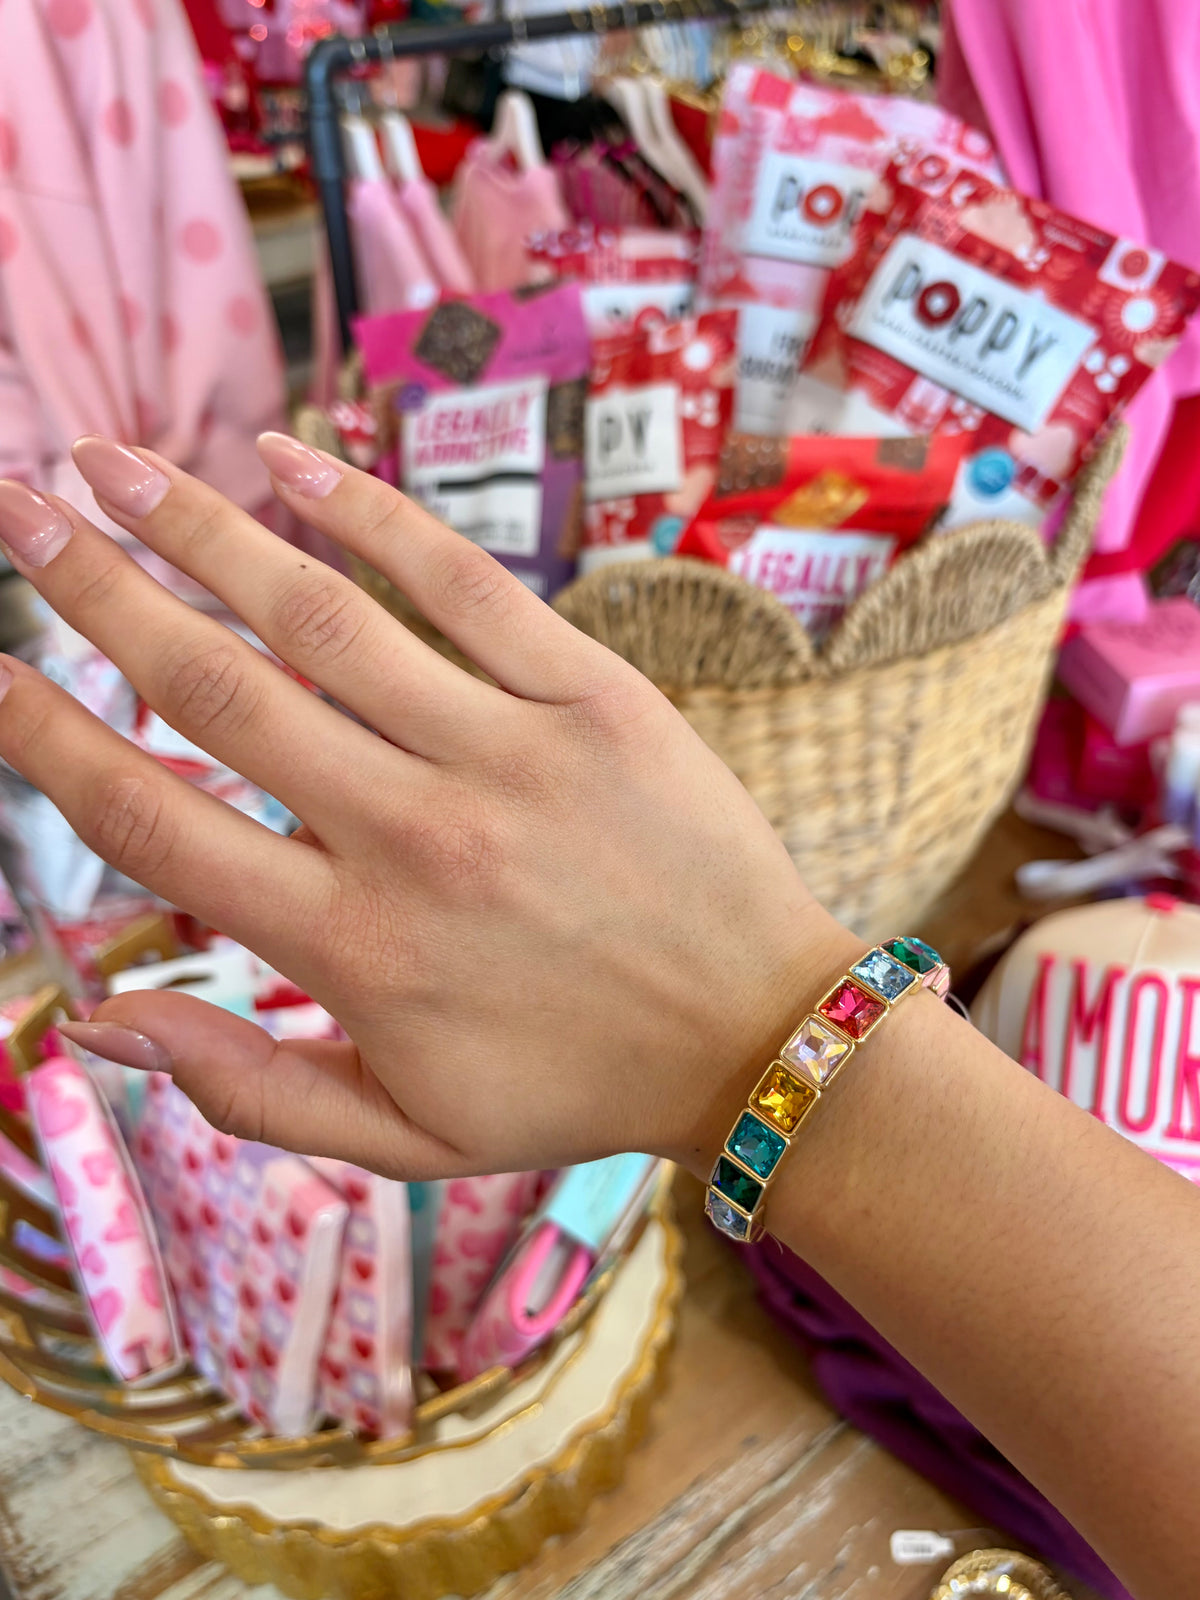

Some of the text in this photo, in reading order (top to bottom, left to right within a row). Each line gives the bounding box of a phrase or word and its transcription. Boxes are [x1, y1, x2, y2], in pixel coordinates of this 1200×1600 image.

[882, 260, 1057, 382] POPPY
[417, 391, 530, 442] LEGALLY
[741, 551, 882, 597] LEGALLY
